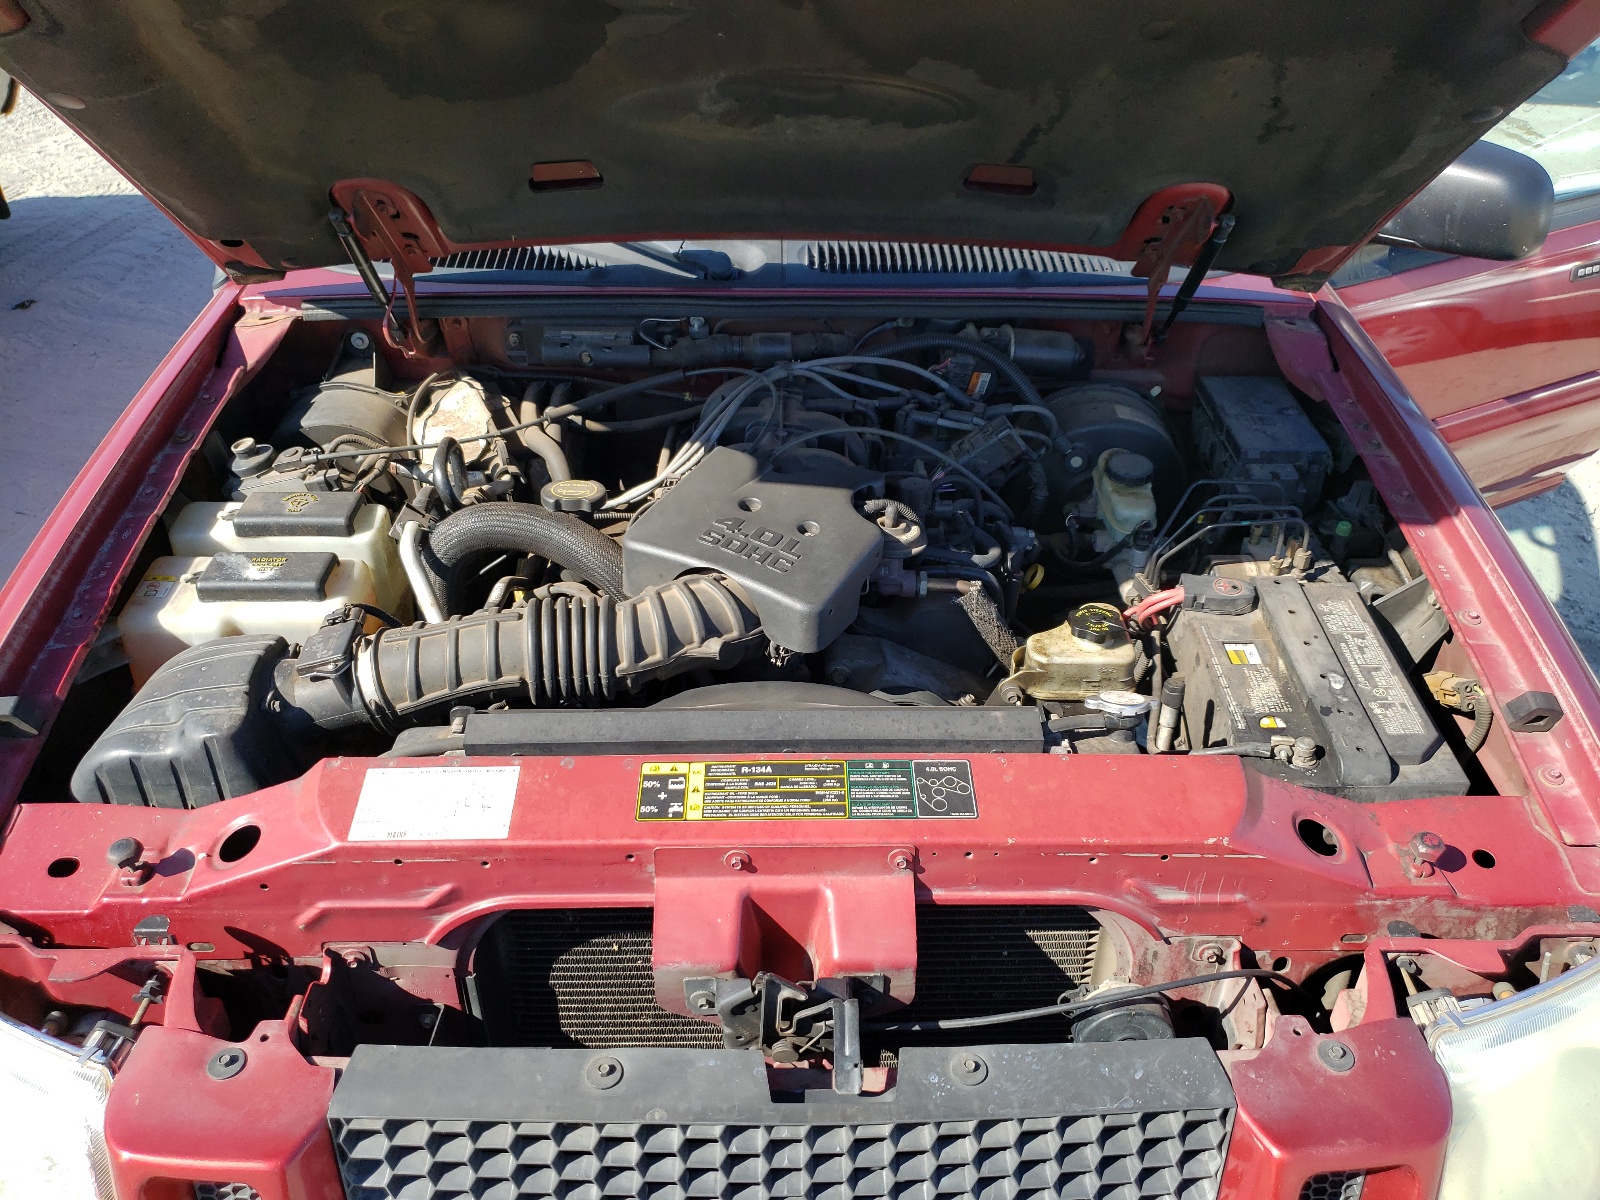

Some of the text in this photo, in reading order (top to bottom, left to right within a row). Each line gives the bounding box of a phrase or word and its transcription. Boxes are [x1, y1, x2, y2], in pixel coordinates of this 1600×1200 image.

[697, 529, 795, 574] SOHC
[741, 765, 773, 774] R-134A
[642, 780, 661, 788] 50%
[640, 805, 659, 813] 50%
